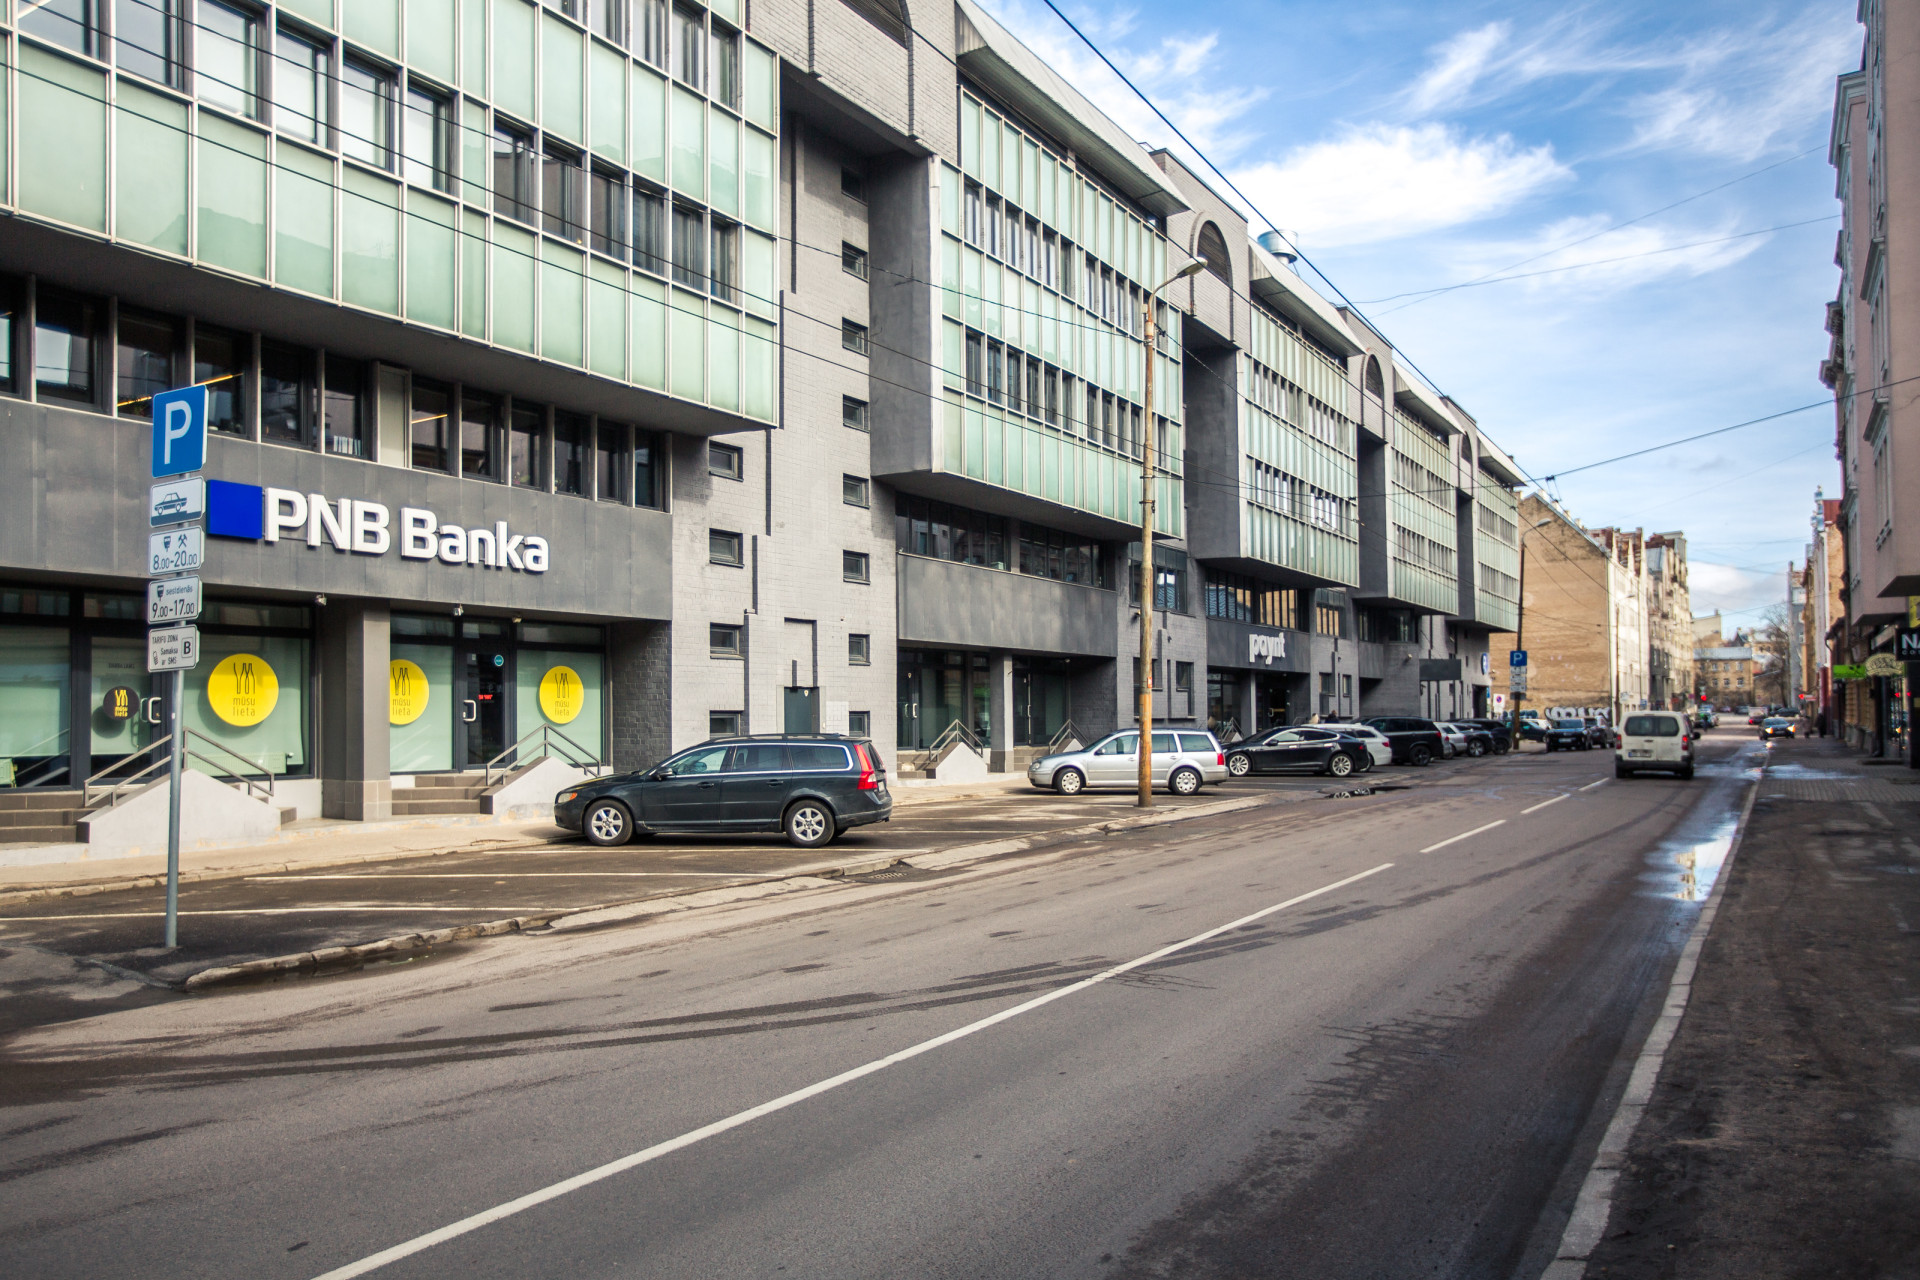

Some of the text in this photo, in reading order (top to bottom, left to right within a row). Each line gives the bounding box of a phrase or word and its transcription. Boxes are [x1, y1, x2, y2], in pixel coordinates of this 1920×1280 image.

[164, 400, 192, 465] P
[264, 487, 549, 572] PNB Banka
[153, 550, 198, 570] 8.00-20.00
[152, 598, 195, 619] 9.00-17.00
[183, 640, 192, 655] B
[1248, 631, 1286, 665] paynt
[1513, 652, 1523, 665] P
[232, 695, 256, 706] mūsu
[392, 697, 411, 707] mūsu
[232, 706, 256, 717] lieta
[392, 706, 411, 716] lieta
[554, 708, 570, 717] lieta
